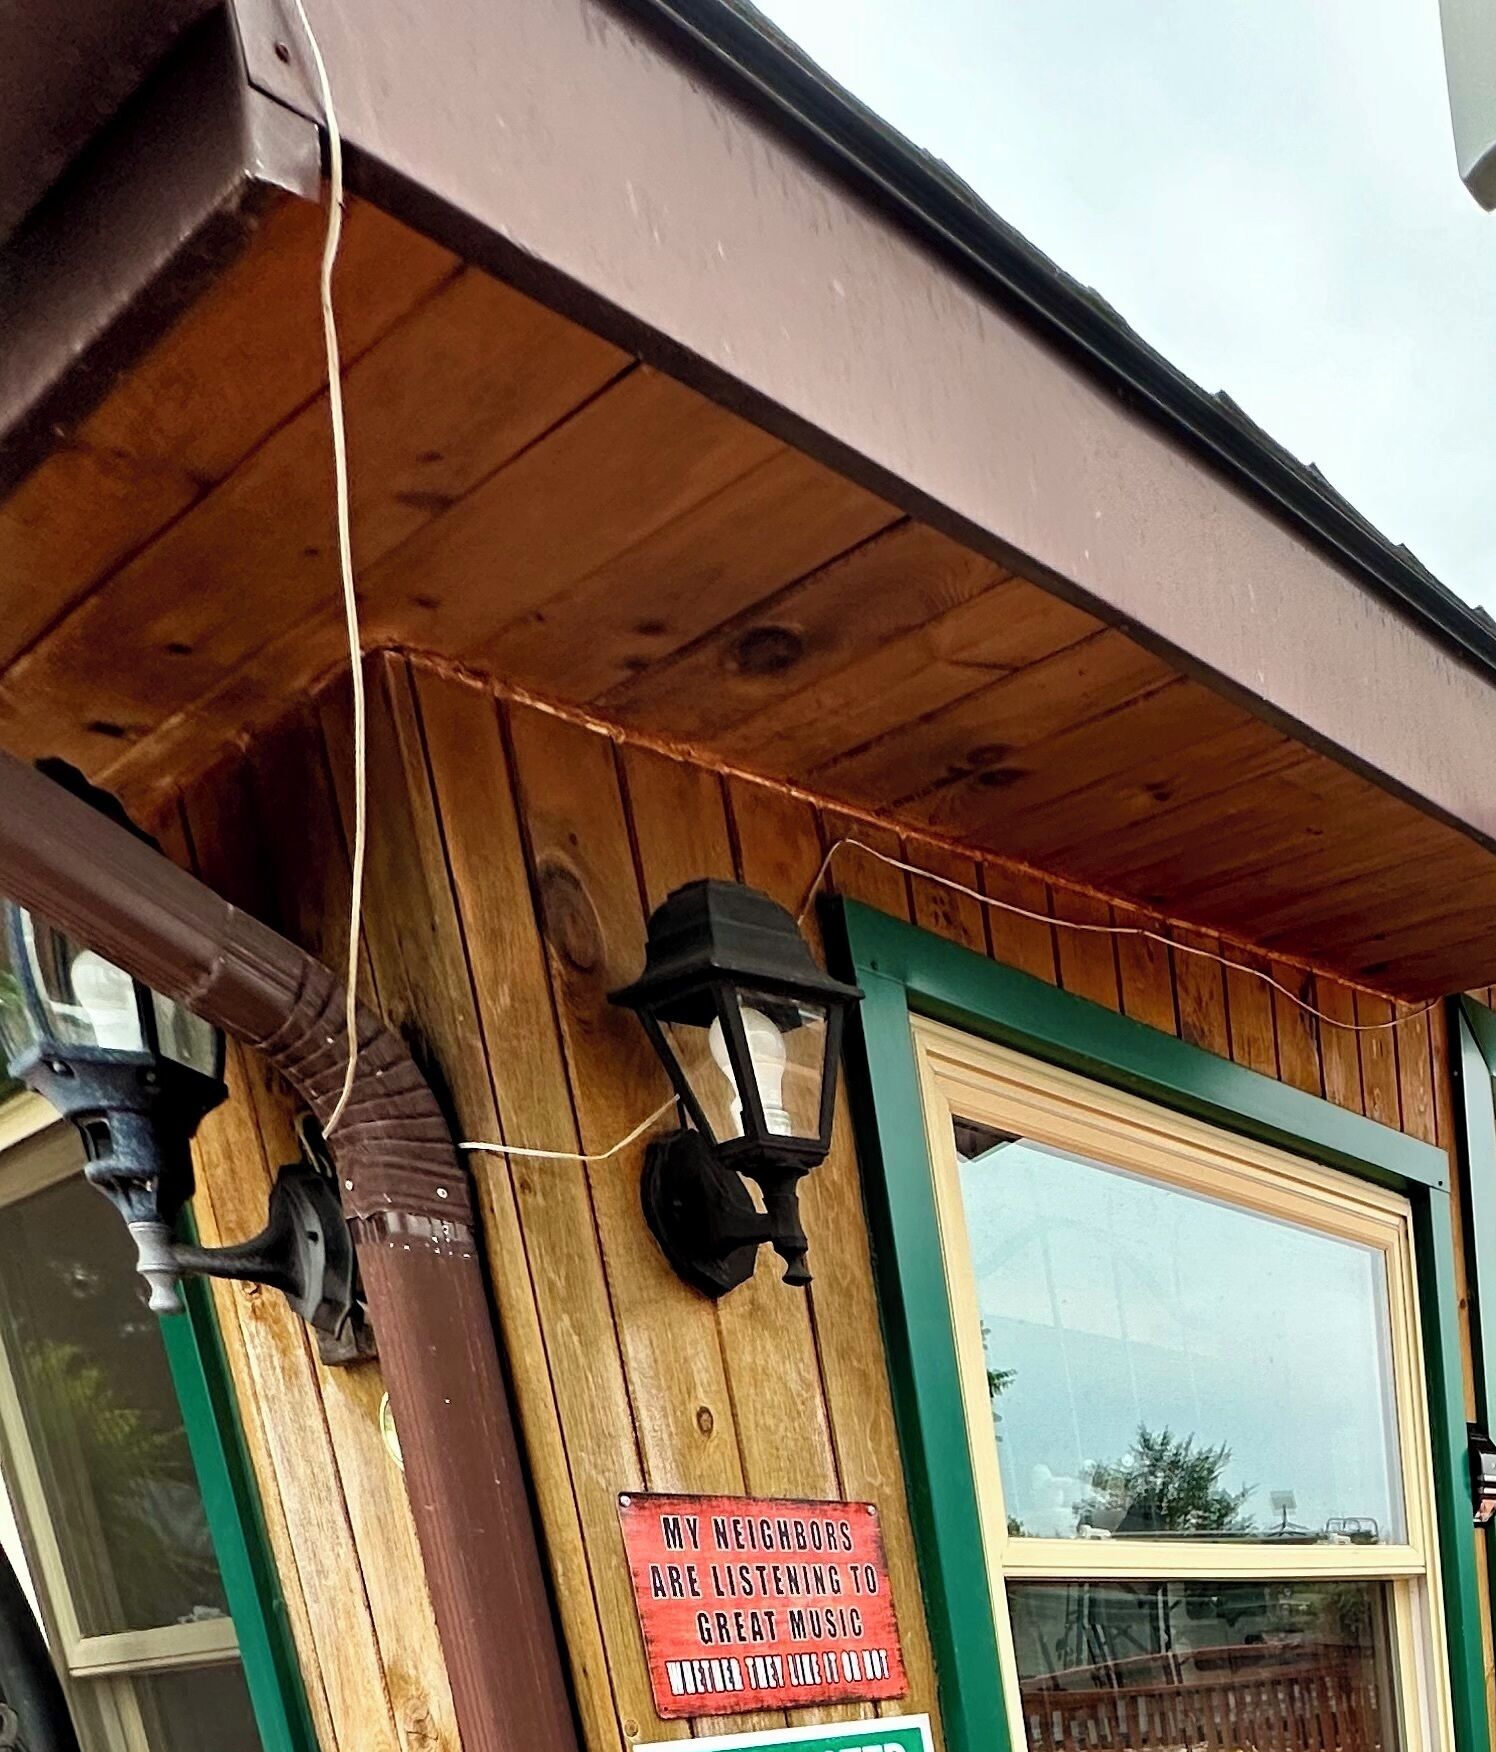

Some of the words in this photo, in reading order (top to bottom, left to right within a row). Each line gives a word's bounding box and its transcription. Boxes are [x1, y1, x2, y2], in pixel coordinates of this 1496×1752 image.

[661, 1516, 698, 1550] MY
[713, 1518, 853, 1551] NEIGHBORS
[650, 1565, 701, 1598] ARE
[711, 1565, 841, 1596] LISTENING
[850, 1565, 877, 1594] TO
[697, 1610, 777, 1645] GREAT
[788, 1608, 863, 1639] MUSIC
[665, 1657, 744, 1695] WHETHER
[744, 1654, 785, 1690] THEY
[787, 1652, 822, 1687] LIKE
[822, 1651, 840, 1684] IT
[841, 1649, 861, 1682] OR
[861, 1648, 890, 1680] NOT
